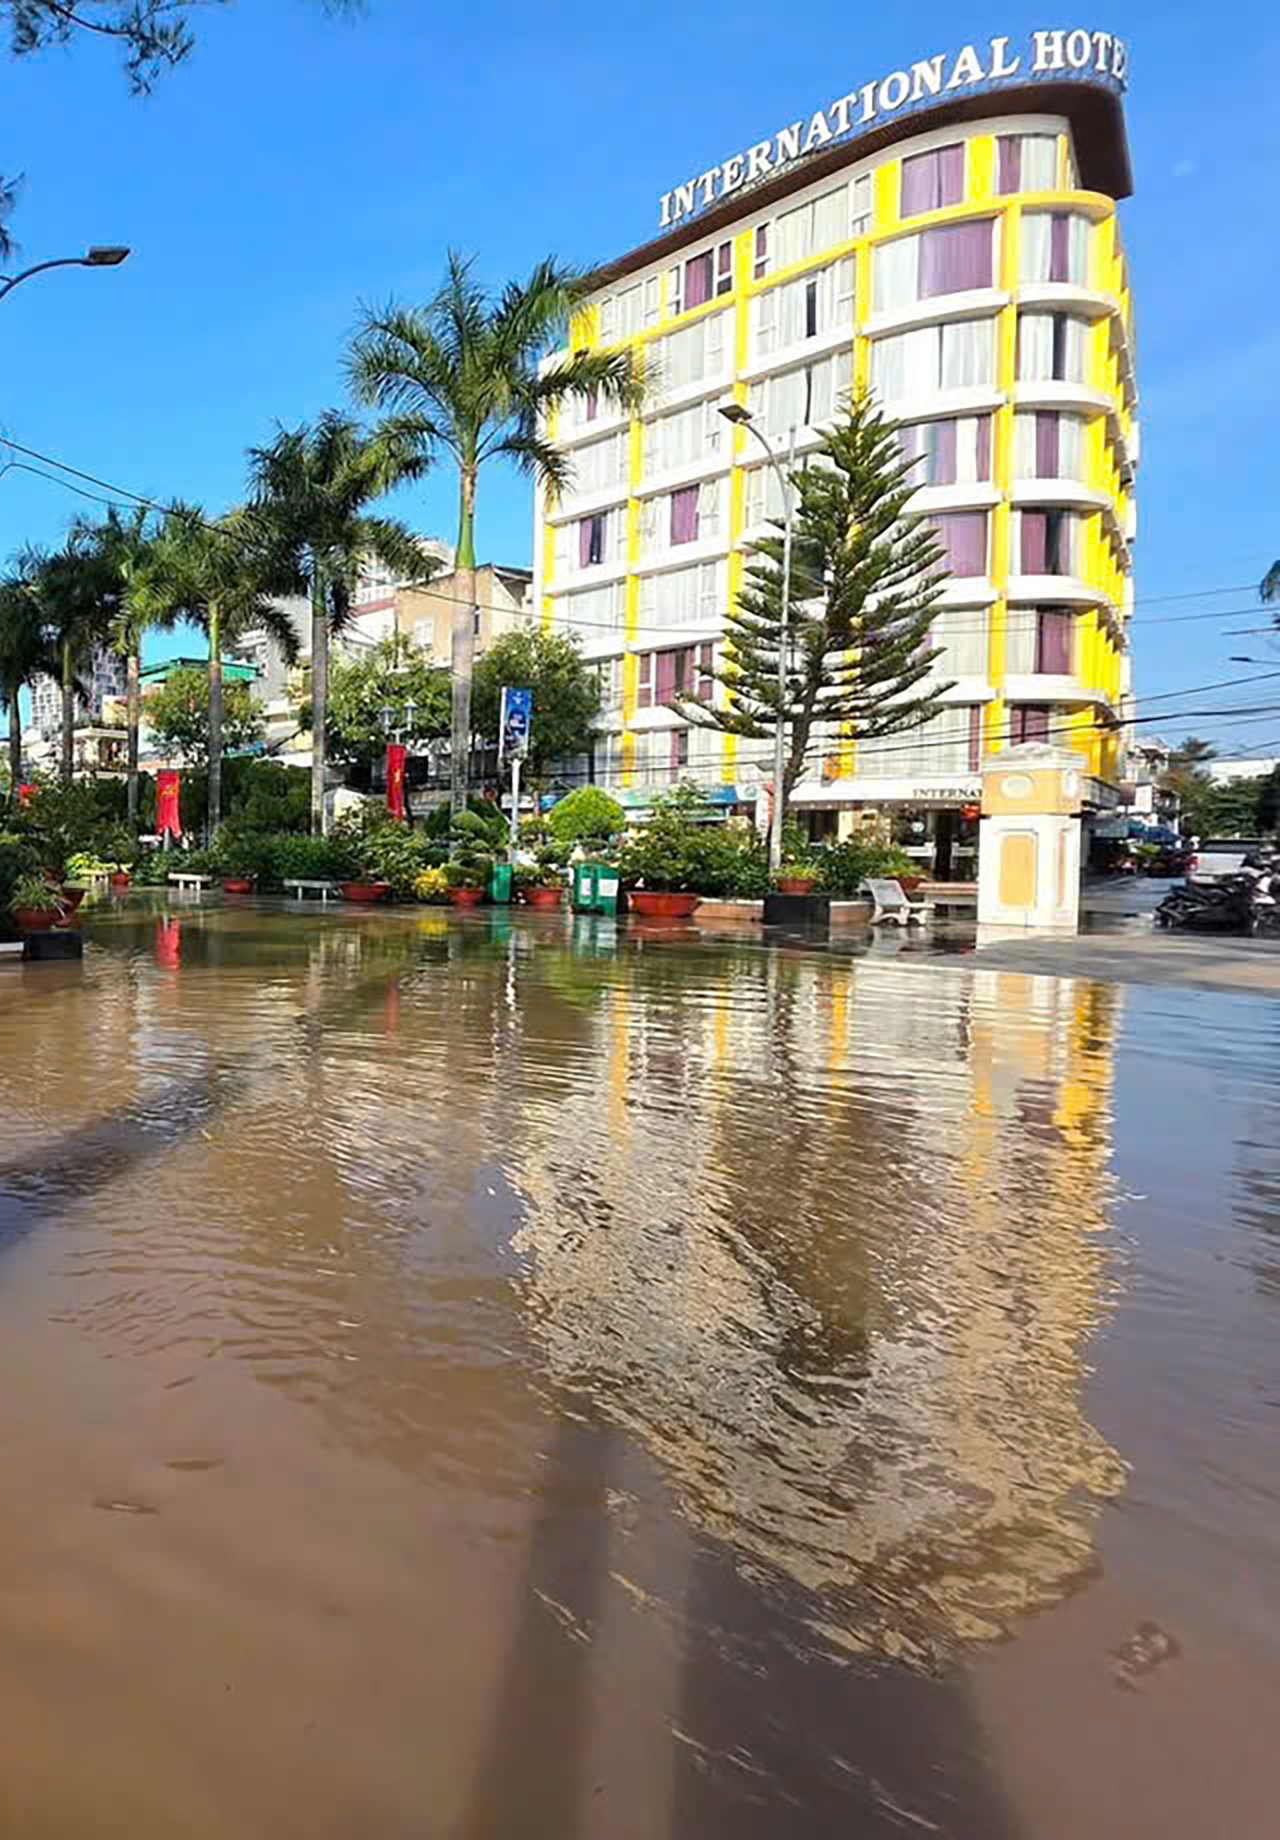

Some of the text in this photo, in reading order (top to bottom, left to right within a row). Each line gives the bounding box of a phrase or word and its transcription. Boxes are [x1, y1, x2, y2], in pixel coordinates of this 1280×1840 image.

[659, 29, 1126, 228] INTERNATIONAL HOTE
[913, 787, 982, 799] INTERNAT
